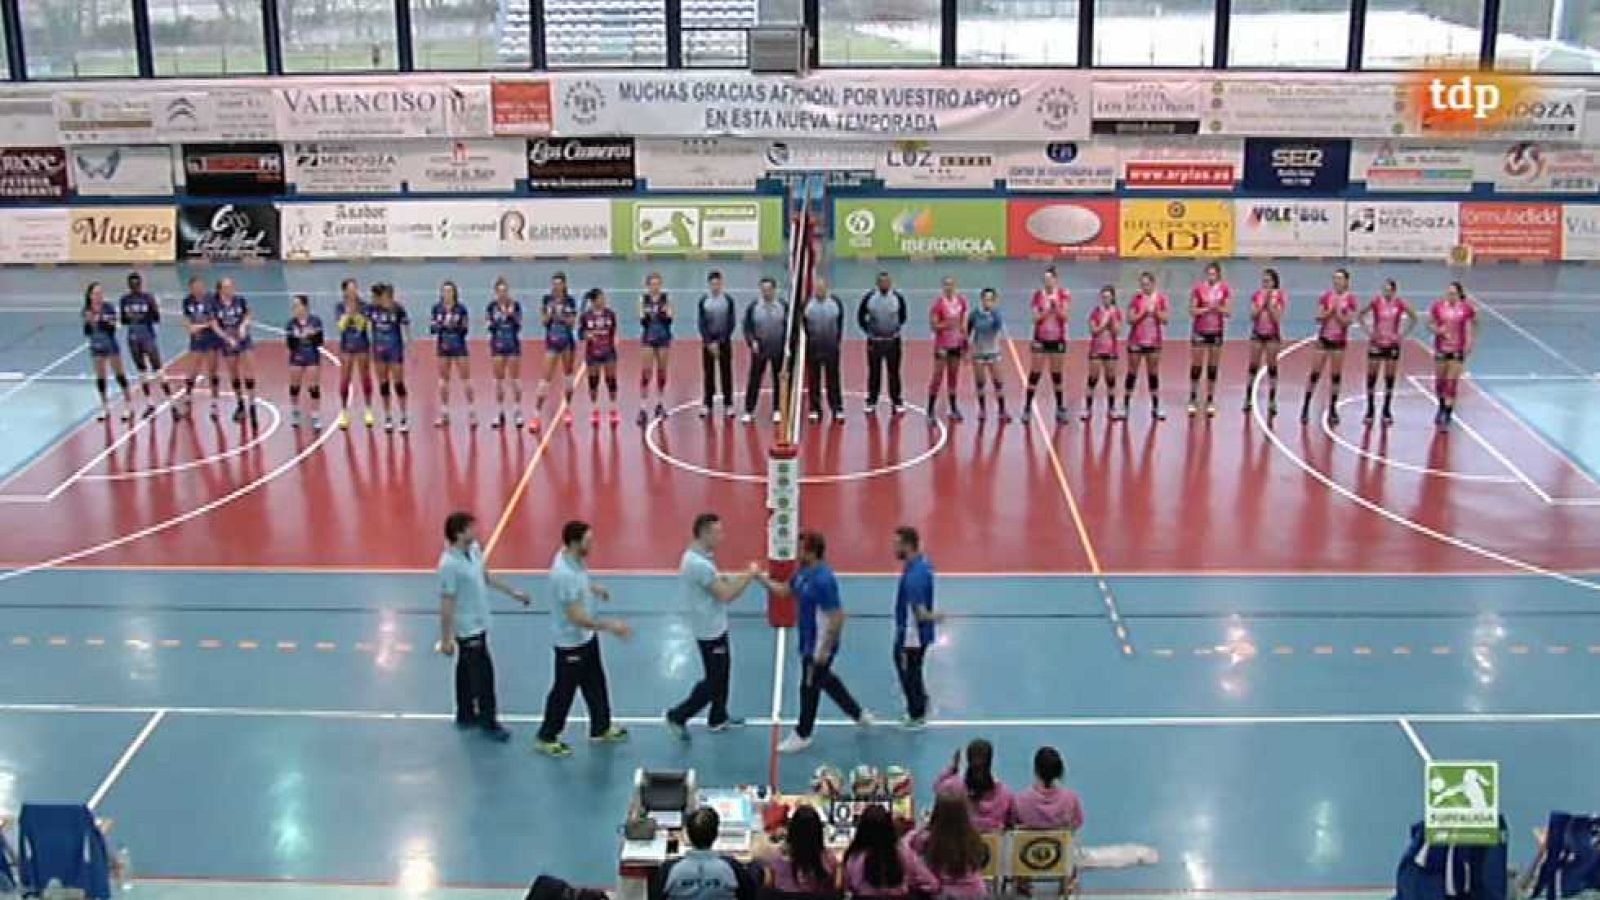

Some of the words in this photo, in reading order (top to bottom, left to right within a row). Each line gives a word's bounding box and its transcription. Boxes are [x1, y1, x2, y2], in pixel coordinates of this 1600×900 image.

[282, 88, 436, 114] VALENCISO
[618, 81, 691, 102] MUCHAS
[692, 82, 766, 103] GRACIAS
[843, 87, 878, 107] POR
[882, 88, 959, 109] VUESTRO
[961, 88, 1021, 109] APOYO
[706, 108, 729, 129] EN
[732, 109, 775, 129] ESTA
[777, 110, 829, 130] NUEVA
[835, 113, 938, 133] TEMPORADA
[72, 216, 172, 250] Muga
[1131, 231, 1222, 252] ADE
